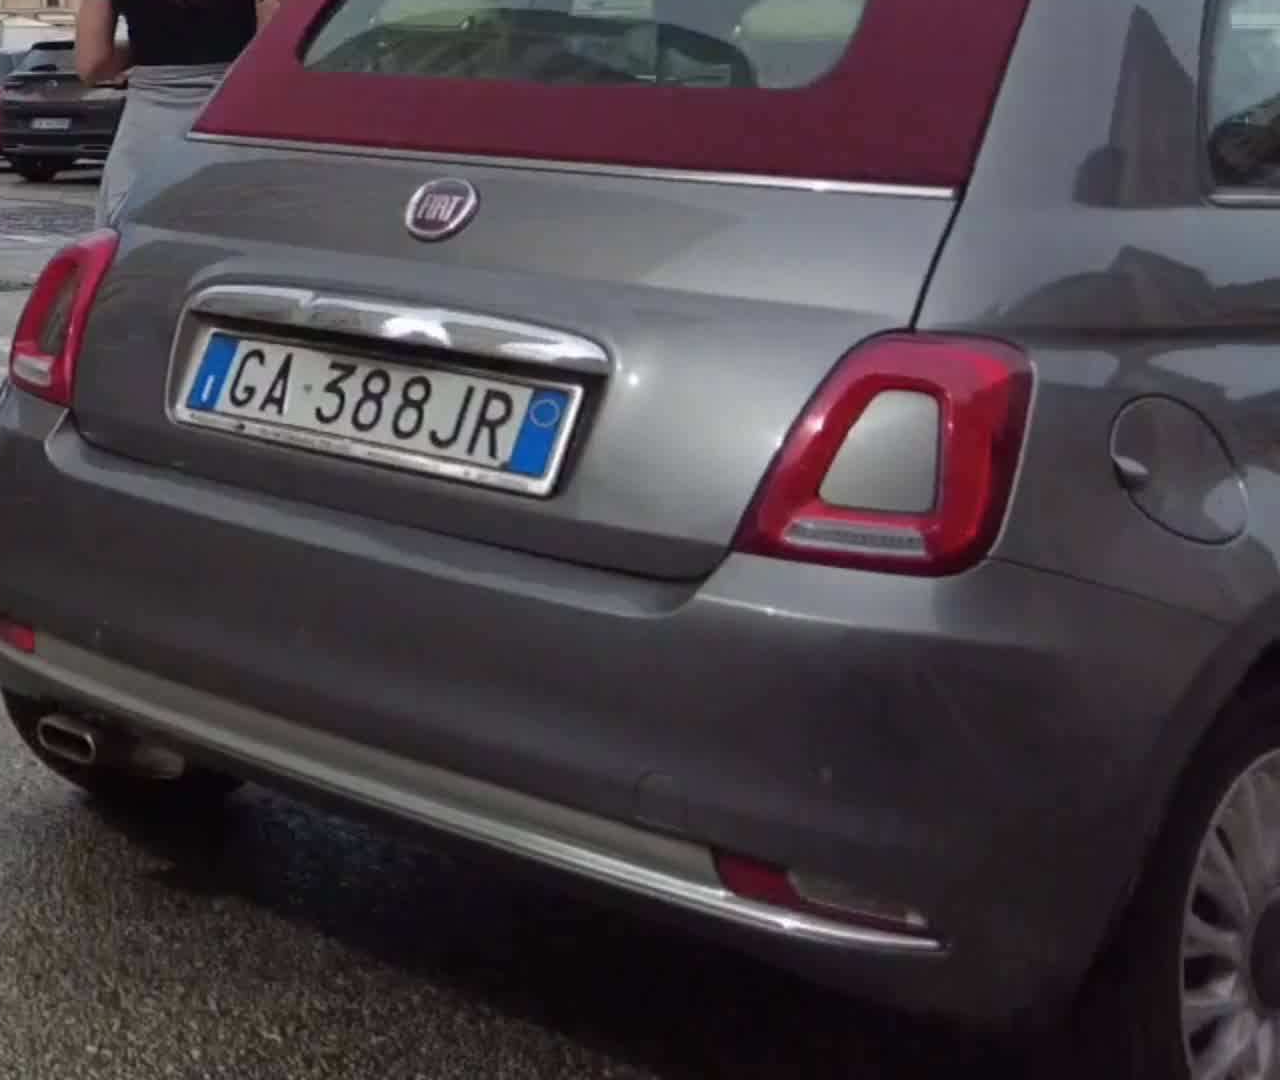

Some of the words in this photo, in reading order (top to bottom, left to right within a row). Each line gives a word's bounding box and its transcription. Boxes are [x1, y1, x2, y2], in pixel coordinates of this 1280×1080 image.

[416, 193, 465, 222] FIAT
[229, 349, 293, 416] GA
[315, 361, 515, 460] 388JR
